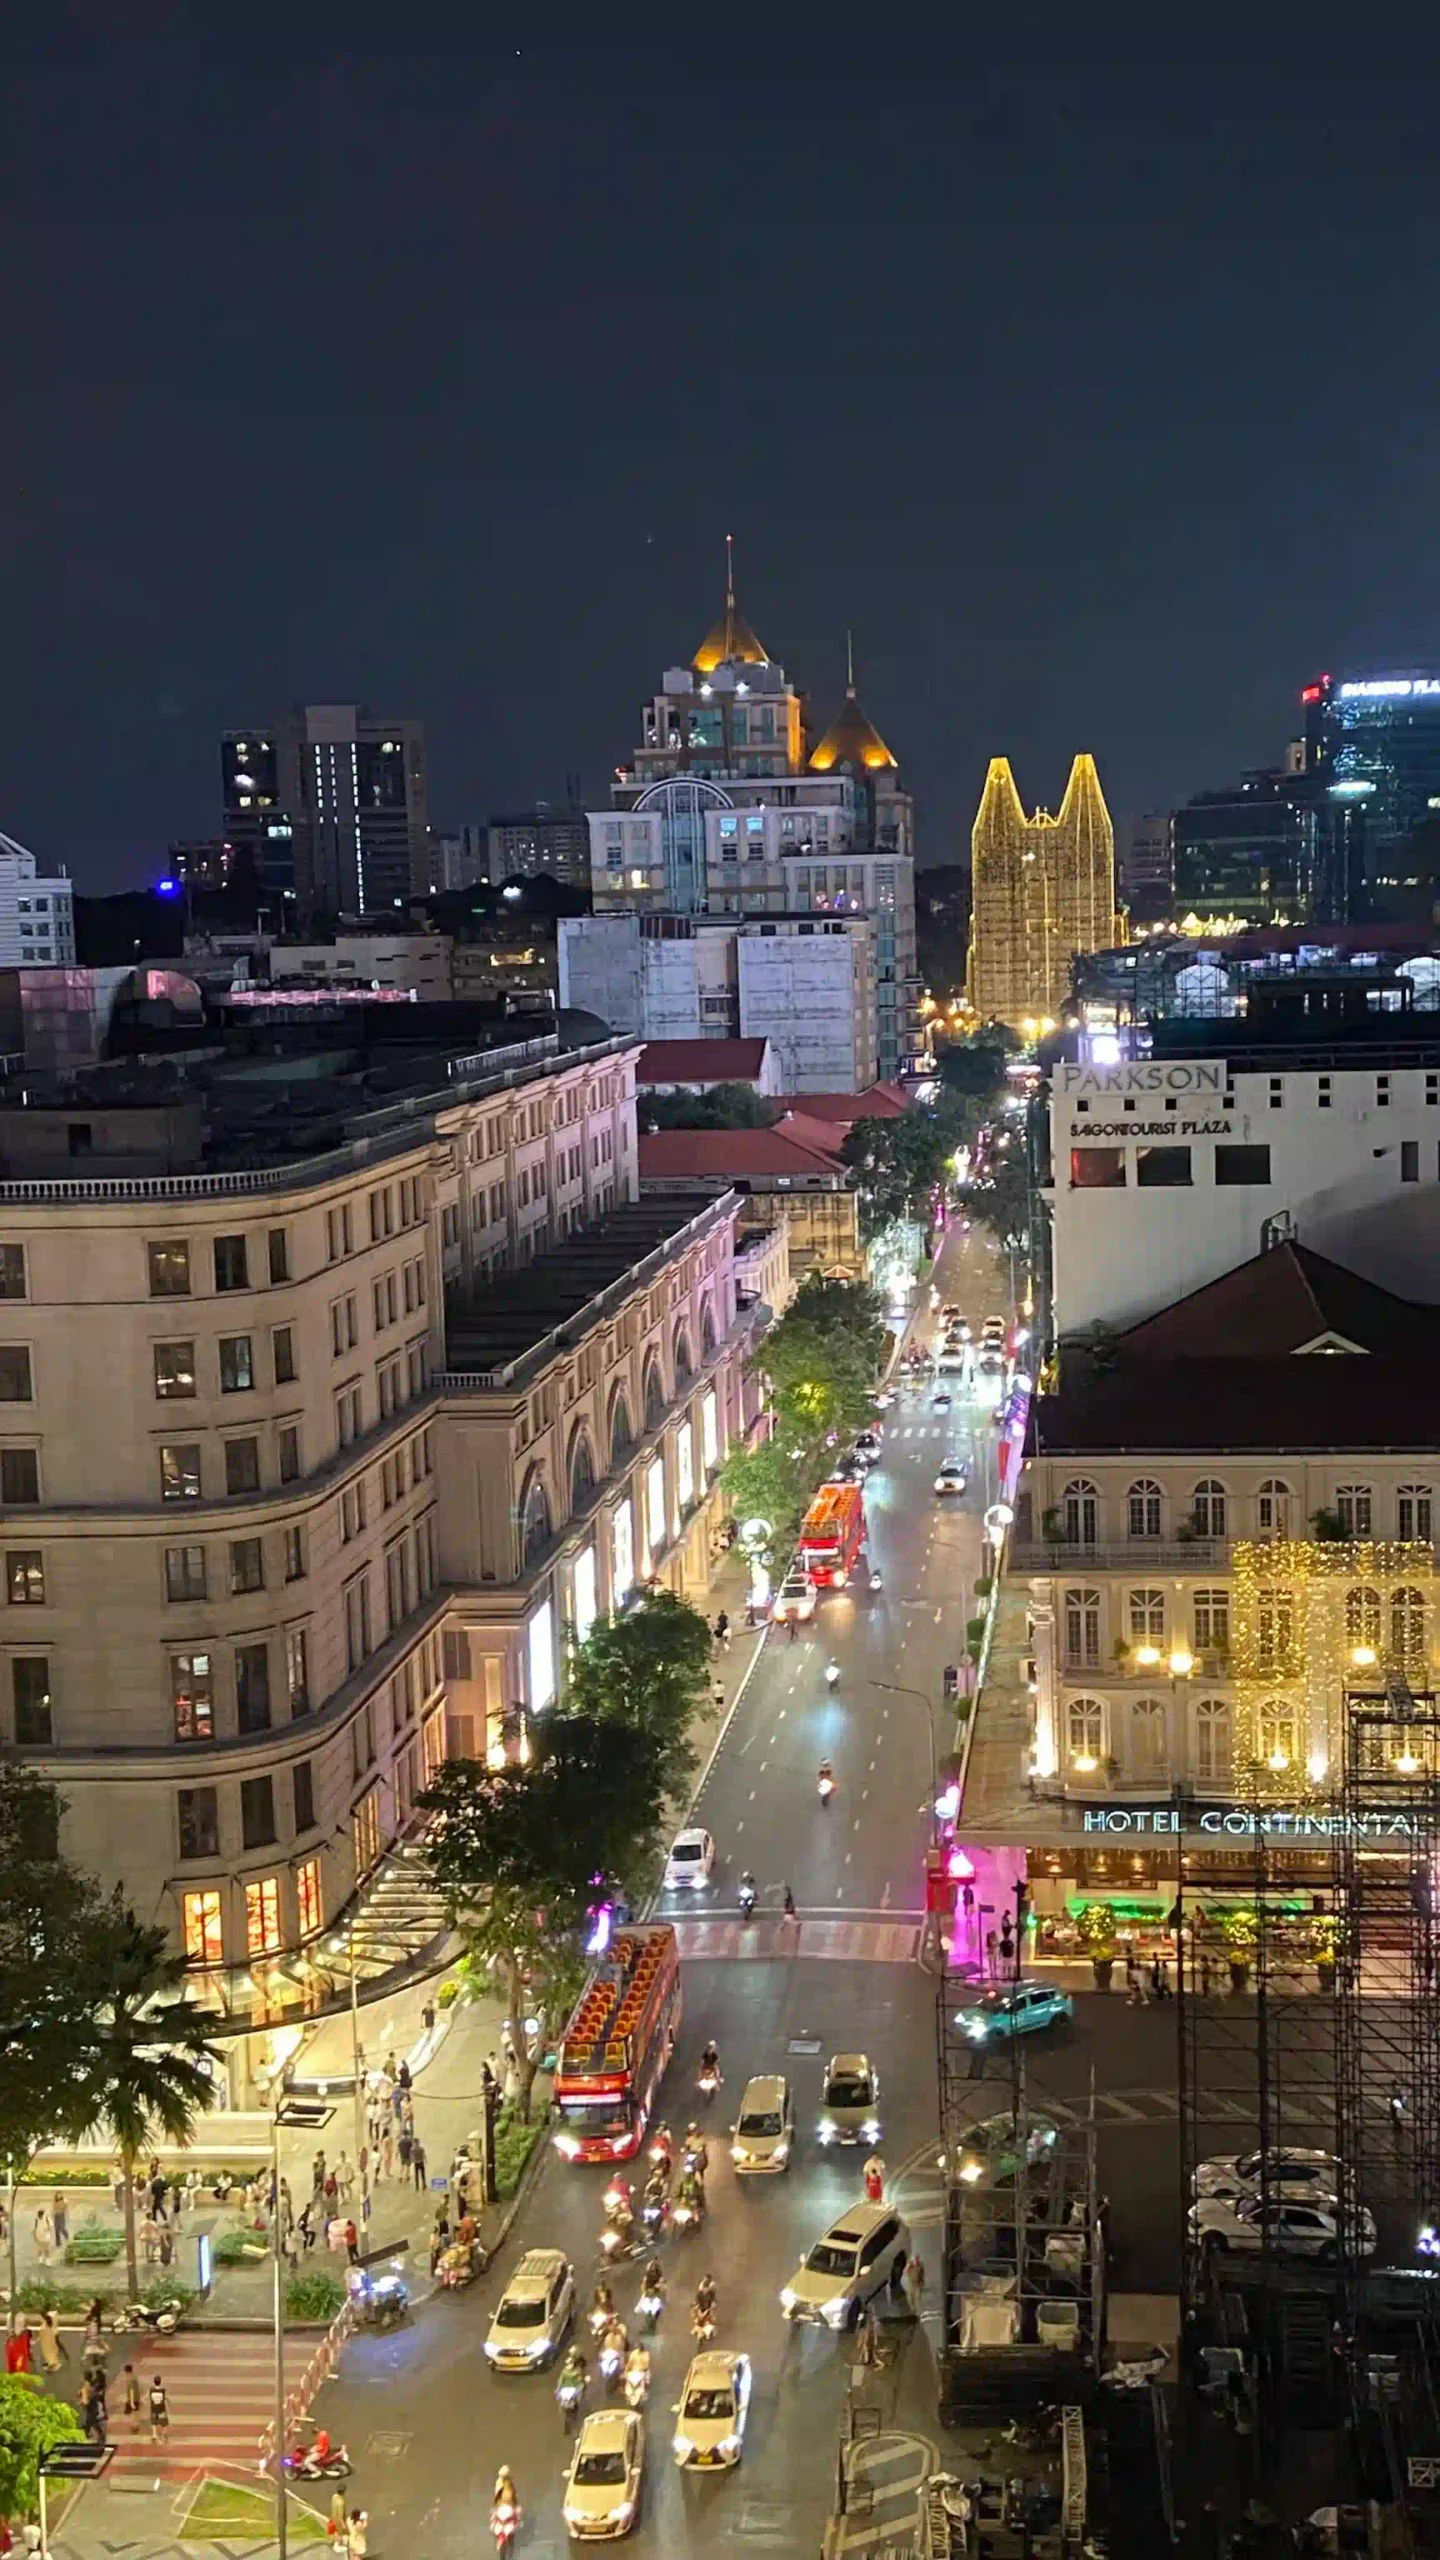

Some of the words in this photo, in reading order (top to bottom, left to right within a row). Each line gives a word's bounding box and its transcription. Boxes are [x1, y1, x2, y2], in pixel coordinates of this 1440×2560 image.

[1064, 1066, 1219, 1092] PARKSON
[1070, 1122, 1177, 1137] SAIGONTOURIST
[1181, 1120, 1231, 1135] PLAZA
[1084, 1810, 1187, 1833] HOTEL
[1200, 1811, 1428, 1836] CONTINENTAL
